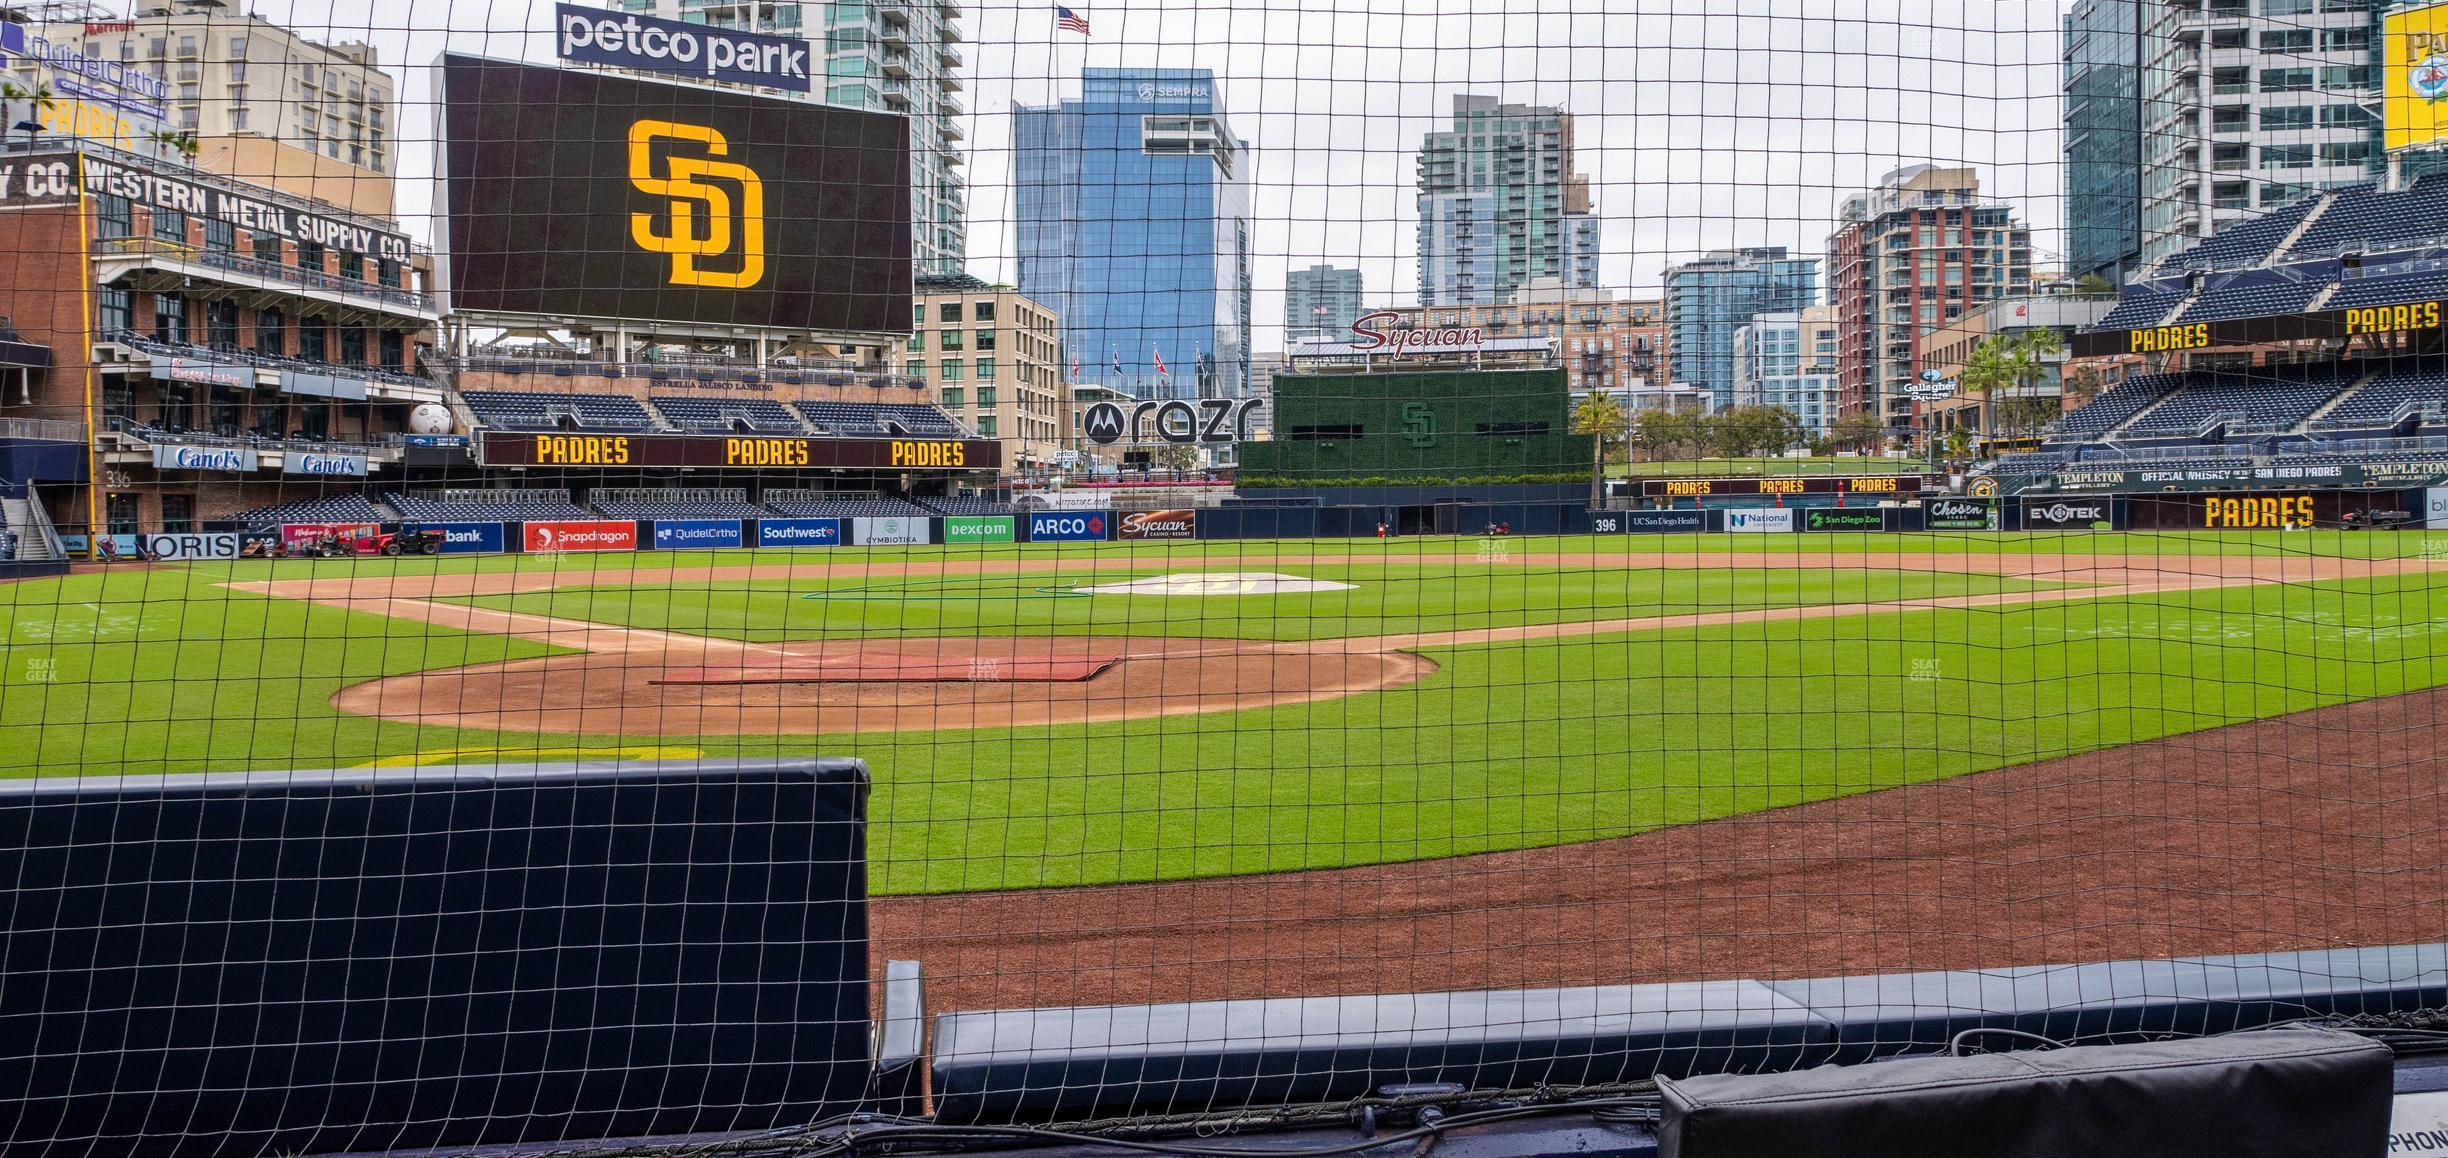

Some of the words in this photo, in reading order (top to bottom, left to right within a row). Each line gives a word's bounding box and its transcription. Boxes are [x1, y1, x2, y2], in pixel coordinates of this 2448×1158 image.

[562, 14, 699, 63] petco
[706, 36, 807, 80] park
[32, 36, 167, 99] QuidelOrtho
[1158, 87, 1208, 97] SEMPRA
[40, 98, 132, 150] PADRES
[26, 161, 79, 197] CO.
[83, 158, 206, 216] WESTERN
[218, 193, 292, 237] METAL
[297, 214, 372, 254] SUPPLY
[379, 235, 410, 263] CO.
[2346, 301, 2439, 335] PADRES
[1349, 311, 1485, 361] Sycuan
[2131, 322, 2209, 353] PADRES
[651, 380, 696, 388] ESTRELLA
[698, 382, 733, 390] JALISCO
[736, 383, 773, 391] LANDING
[1904, 383, 1957, 393] Gallagher
[1130, 399, 1265, 444] razr
[177, 448, 241, 470] Canel's
[536, 435, 629, 464] PADRES
[727, 438, 809, 465] PADRES
[892, 440, 964, 466] PADRES
[302, 454, 355, 474] Canel's
[2360, 462, 2448, 477] TEMPLETON
[106, 470, 131, 489] 336
[2056, 472, 2125, 485] TEMPLETON
[2141, 471, 2184, 482] OFFICIAL
[2186, 470, 2230, 480] WHISKEY
[2255, 468, 2274, 479] SAN
[2276, 467, 2303, 478] DIEGO
[2305, 466, 2342, 477] PADRES
[1667, 481, 1711, 495] PADRES
[1851, 479, 1897, 492] PADRES
[1749, 513, 1788, 523] National
[1931, 501, 1983, 516] Chosen
[2205, 495, 2314, 527] PADRES
[1033, 518, 1086, 535] ARCO
[1123, 512, 1187, 538] Sycuan
[1595, 519, 1617, 532] 396
[1634, 518, 1645, 526] UC
[1645, 518, 1658, 526] San
[1659, 518, 1678, 527] Diego
[1678, 518, 1699, 526] Health
[1825, 516, 1841, 524] San
[1841, 516, 1864, 525] Diego
[1865, 516, 1881, 524] Zoo
[558, 530, 630, 543] Snapdragon
[676, 528, 736, 540] QuidelOrtho
[764, 526, 827, 539] Southwest
[866, 536, 917, 544] CYMBIOTIKA
[152, 535, 235, 558] ORIS
[2389, 1130, 2448, 1152] PHON
